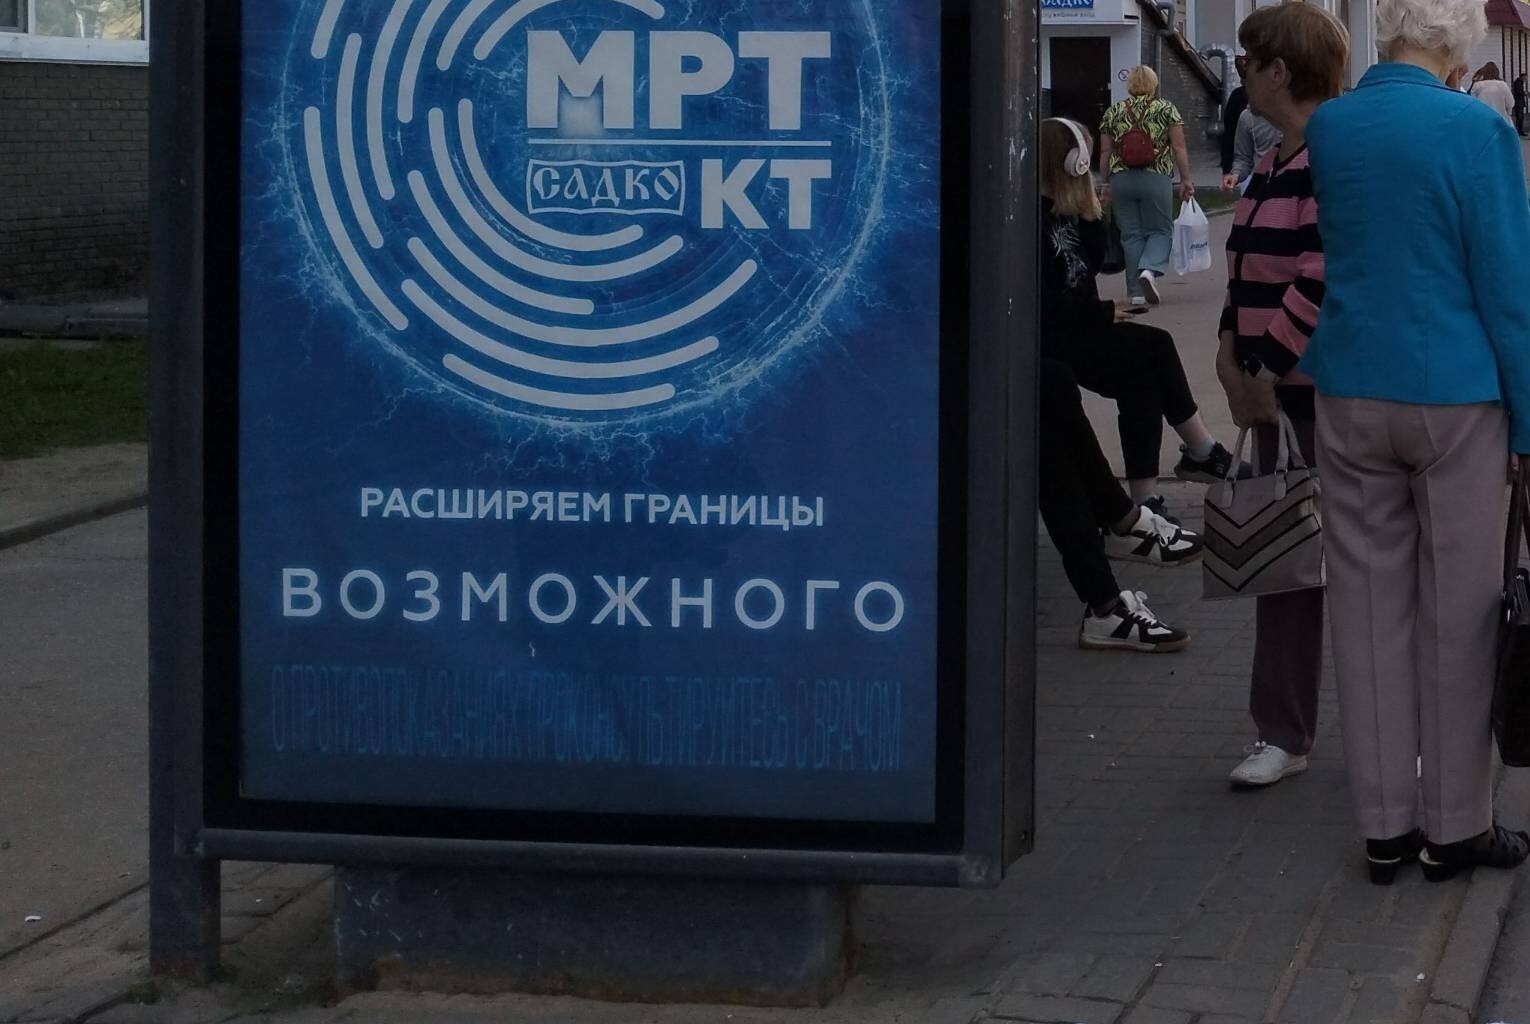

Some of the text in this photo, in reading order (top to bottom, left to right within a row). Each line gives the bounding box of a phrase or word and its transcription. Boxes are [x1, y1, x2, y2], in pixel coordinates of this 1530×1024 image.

[525, 30, 832, 131] МРТ
[531, 159, 832, 230] САДКО КТ
[360, 486, 825, 531] РАСШИРЯЕМ ГРАНИЦЫ
[281, 567, 905, 632] ВОЗМОЖНОГО
